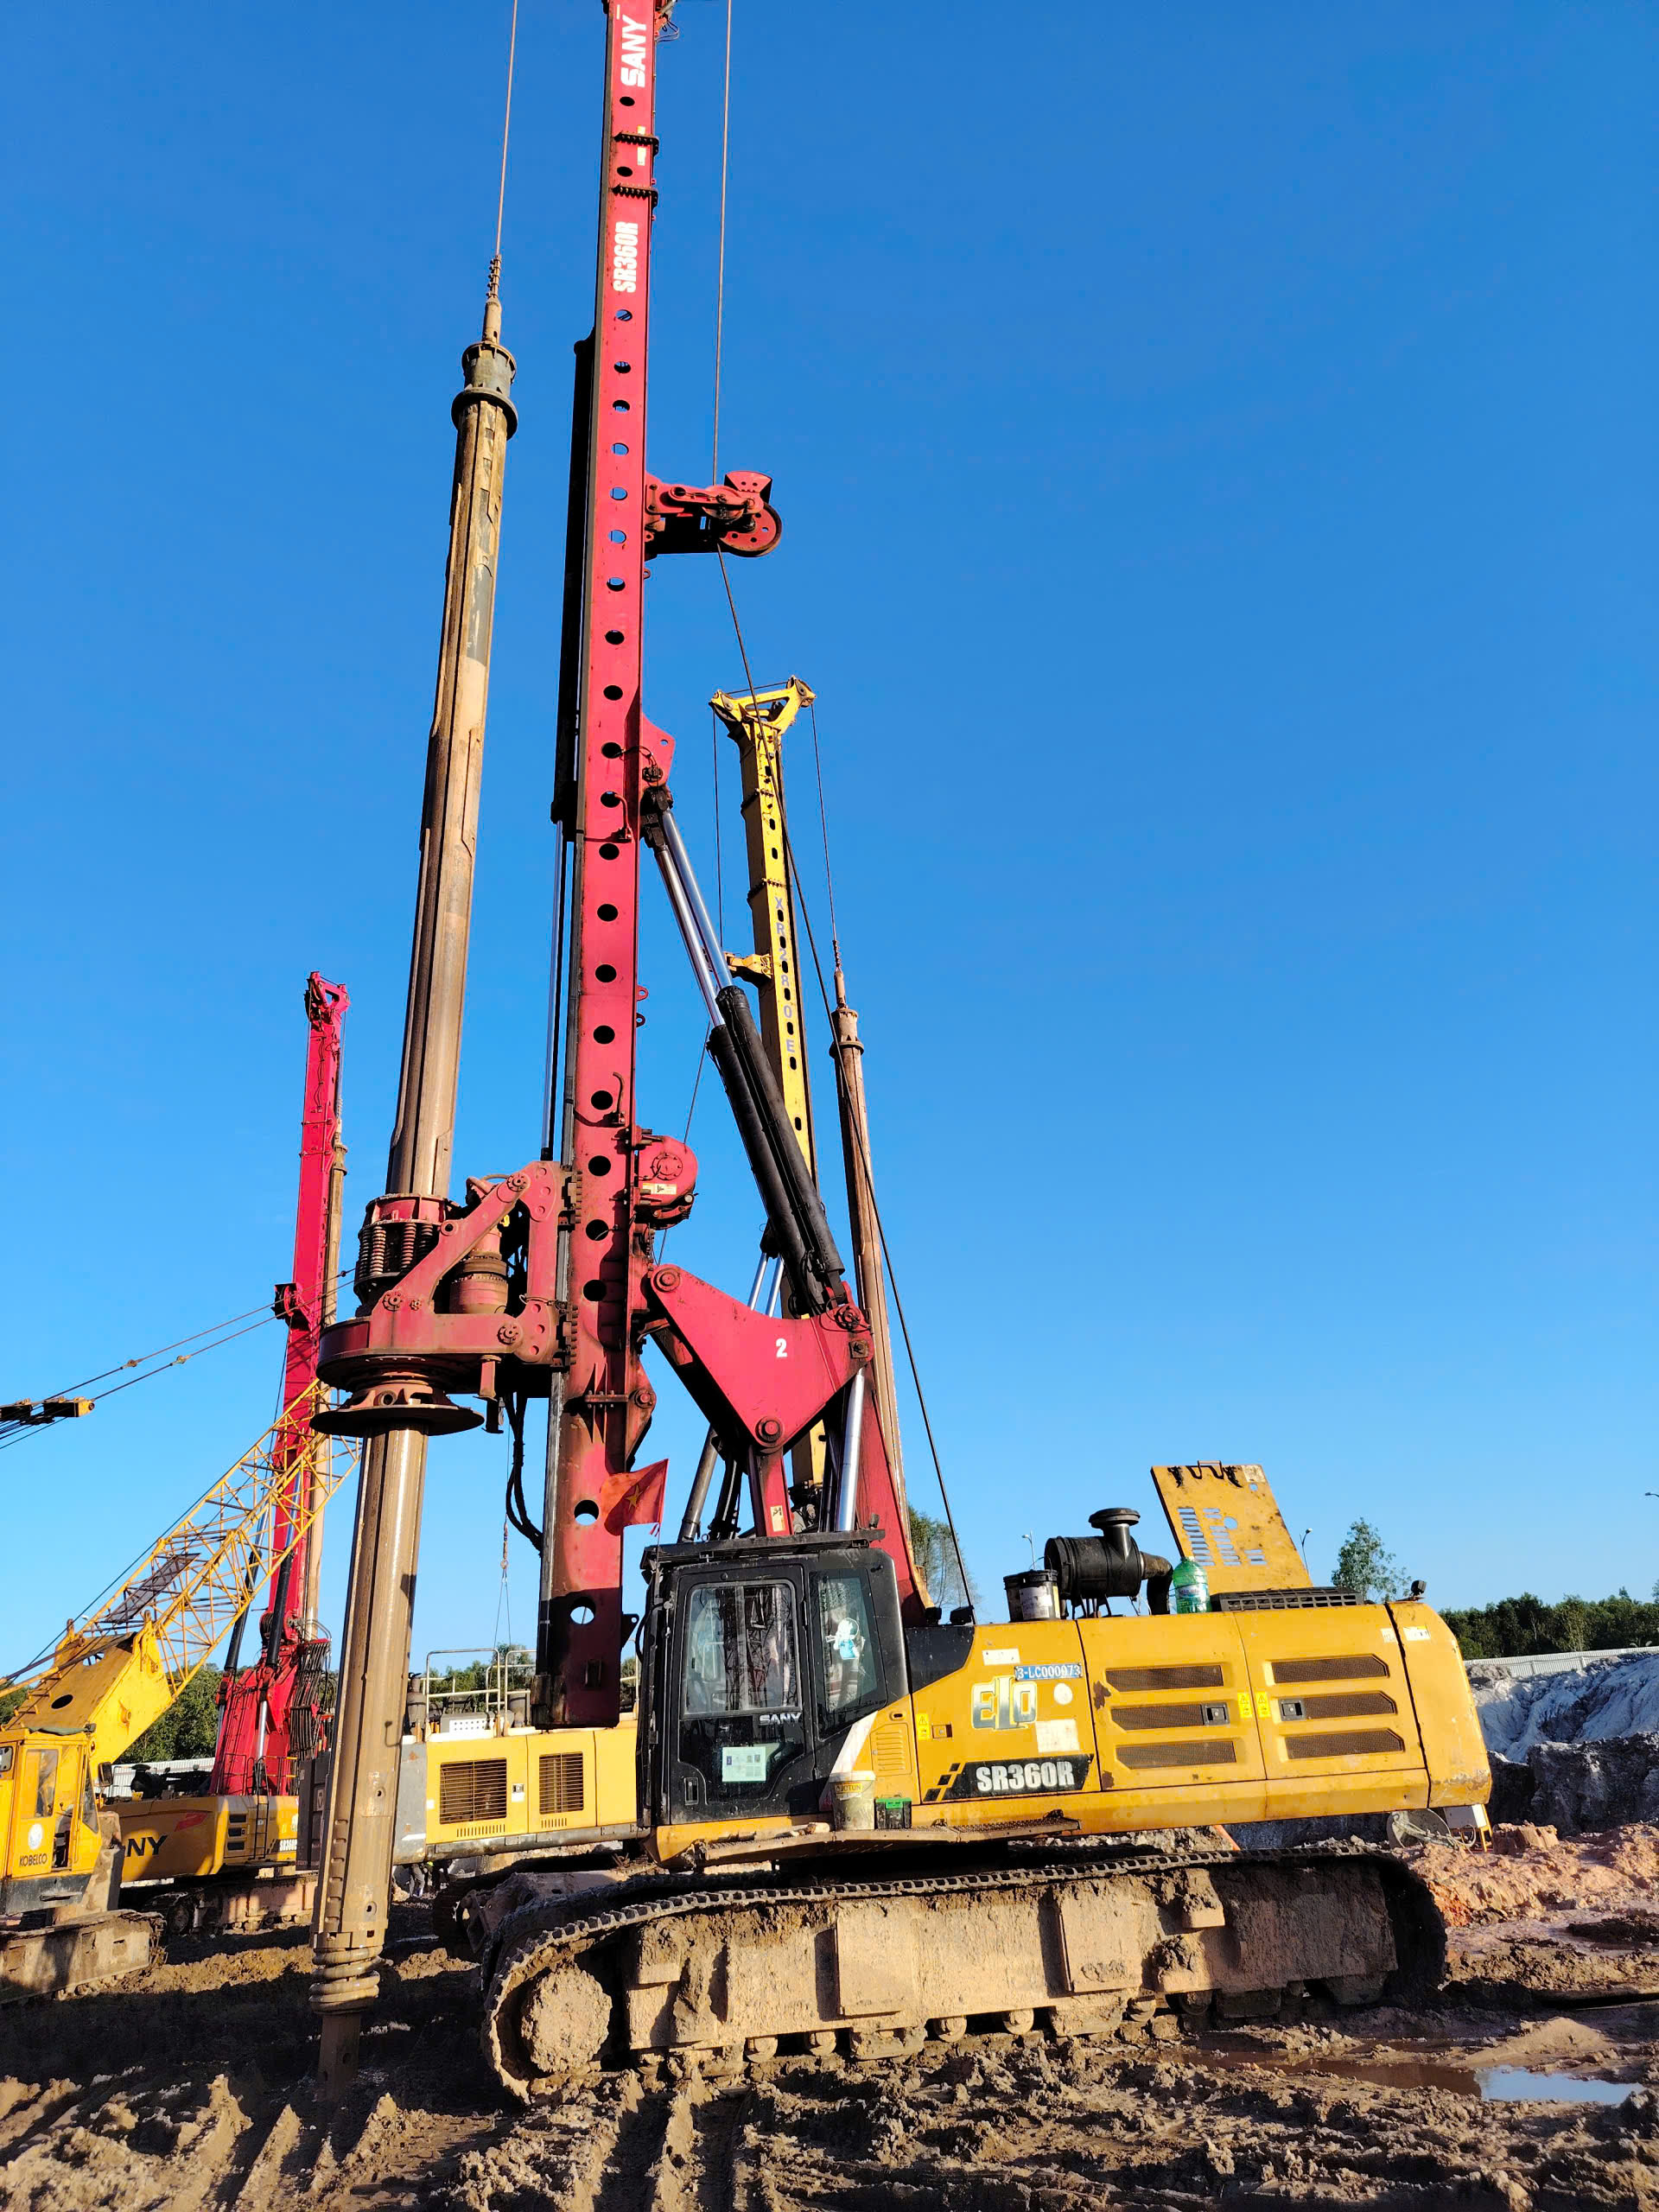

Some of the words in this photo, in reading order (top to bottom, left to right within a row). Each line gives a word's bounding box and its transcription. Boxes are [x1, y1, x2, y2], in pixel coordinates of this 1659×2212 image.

[620, 14, 646, 87] SANY
[613, 221, 639, 293] SR360R
[776, 1338, 787, 1357] 2
[759, 1712, 802, 1726] SANY
[976, 1761, 1075, 1791] SR360R
[19, 1853, 48, 1866] KOBELCO
